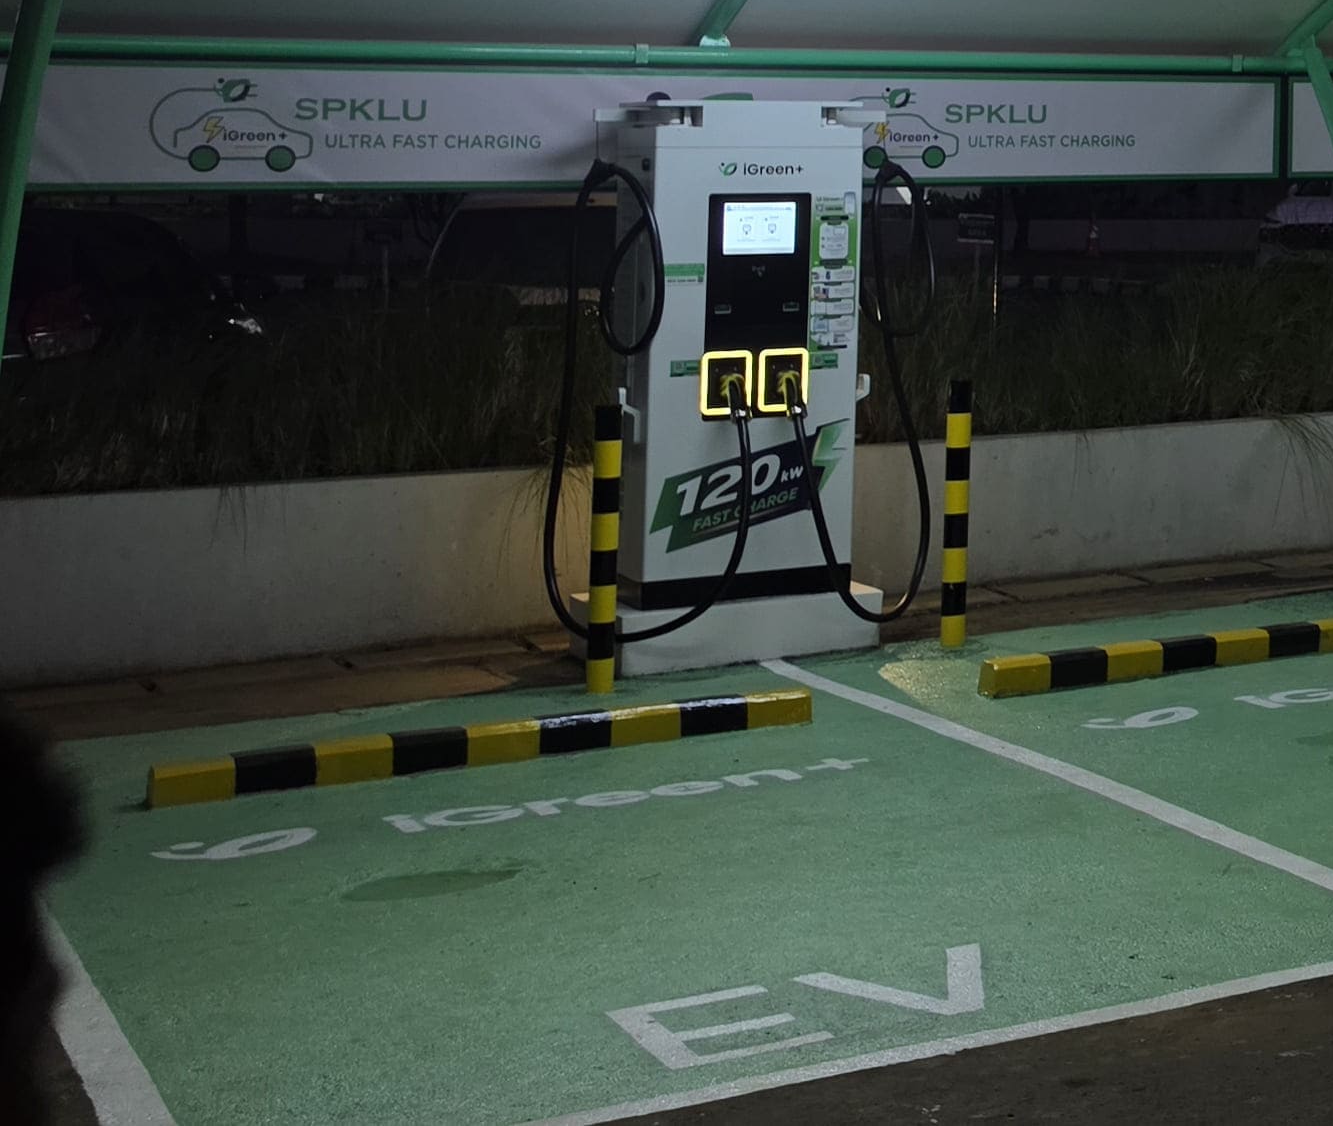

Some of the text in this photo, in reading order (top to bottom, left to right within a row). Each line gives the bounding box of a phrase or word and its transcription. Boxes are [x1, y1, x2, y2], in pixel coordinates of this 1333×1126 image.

[295, 98, 428, 122] SPKLU
[945, 104, 1048, 124] SPKLU
[324, 134, 541, 150] ULTRA FAST CHARGING
[968, 135, 1136, 148] ULTRA FAST CHARGING
[676, 454, 804, 517] 120 kW
[692, 508, 732, 532] FAST
[604, 942, 985, 1070] EV
